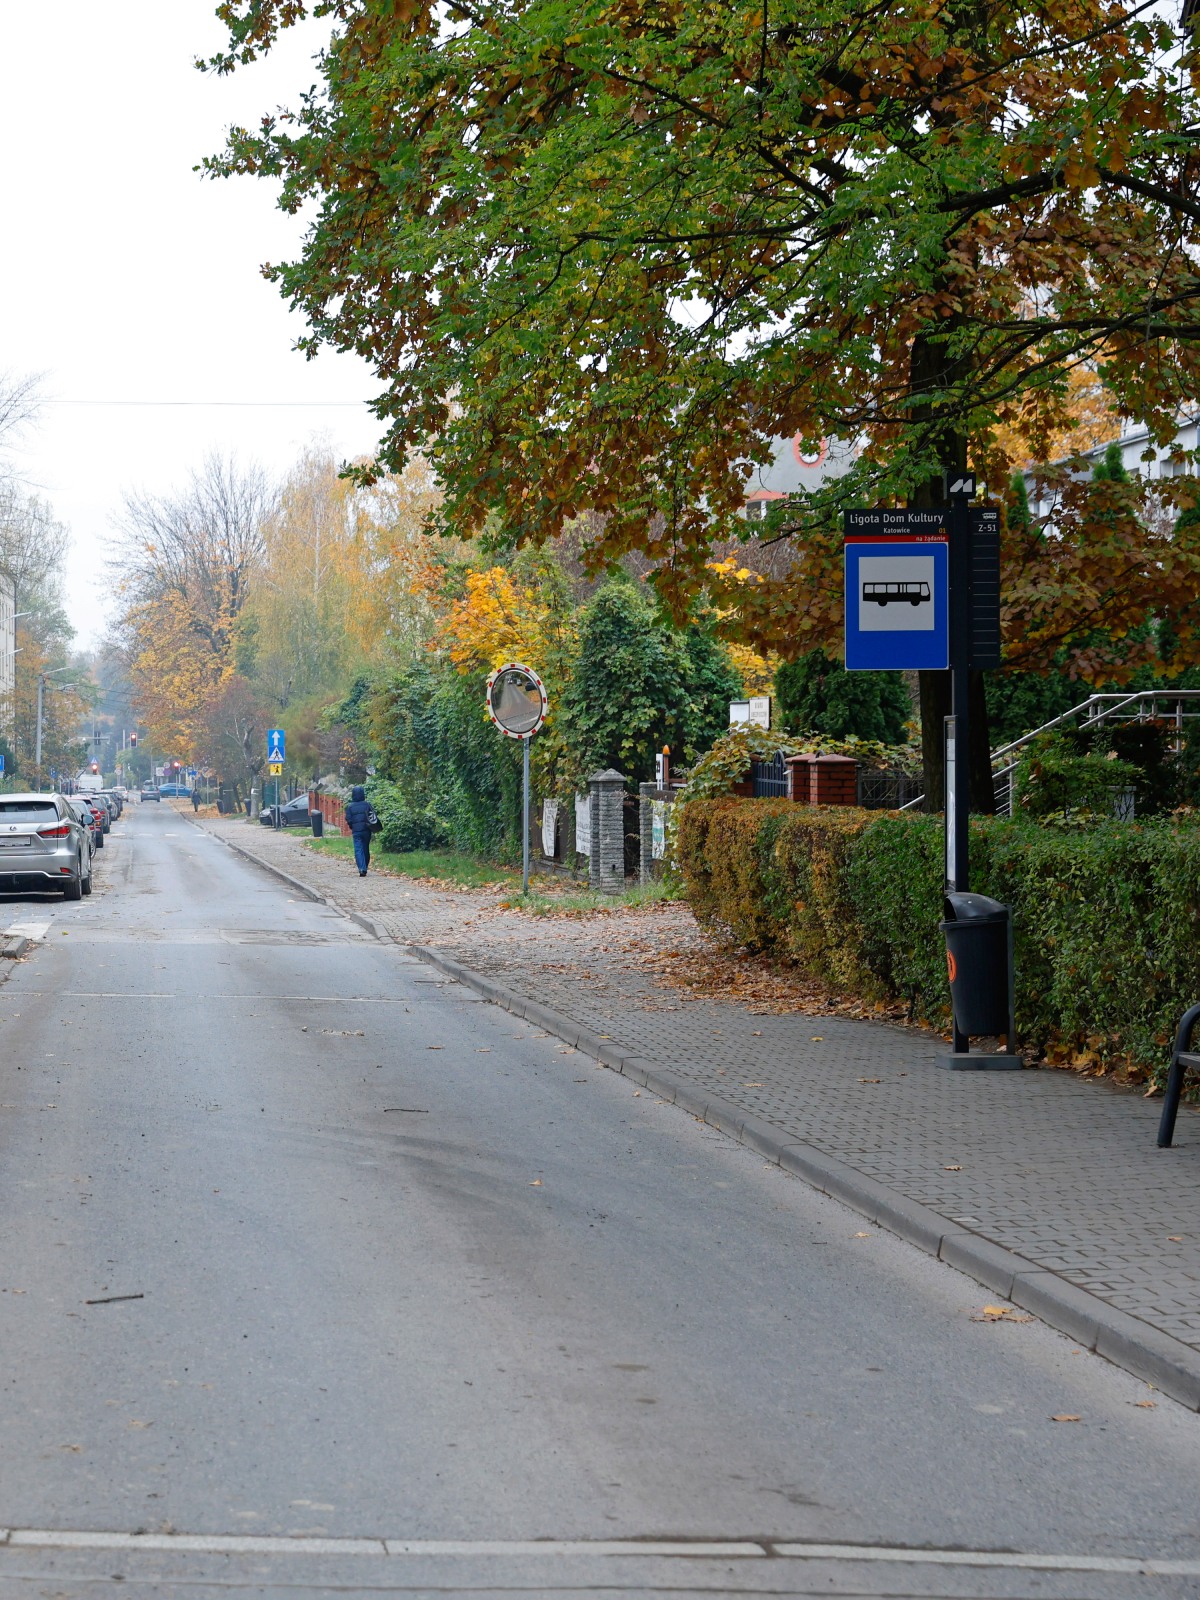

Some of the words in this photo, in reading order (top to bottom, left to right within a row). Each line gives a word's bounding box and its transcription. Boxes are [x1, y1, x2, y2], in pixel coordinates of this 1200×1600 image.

[850, 513, 879, 525] Ligota
[883, 513, 904, 523] Dom
[908, 512, 943, 524] Kultury
[978, 524, 997, 532] Z-51
